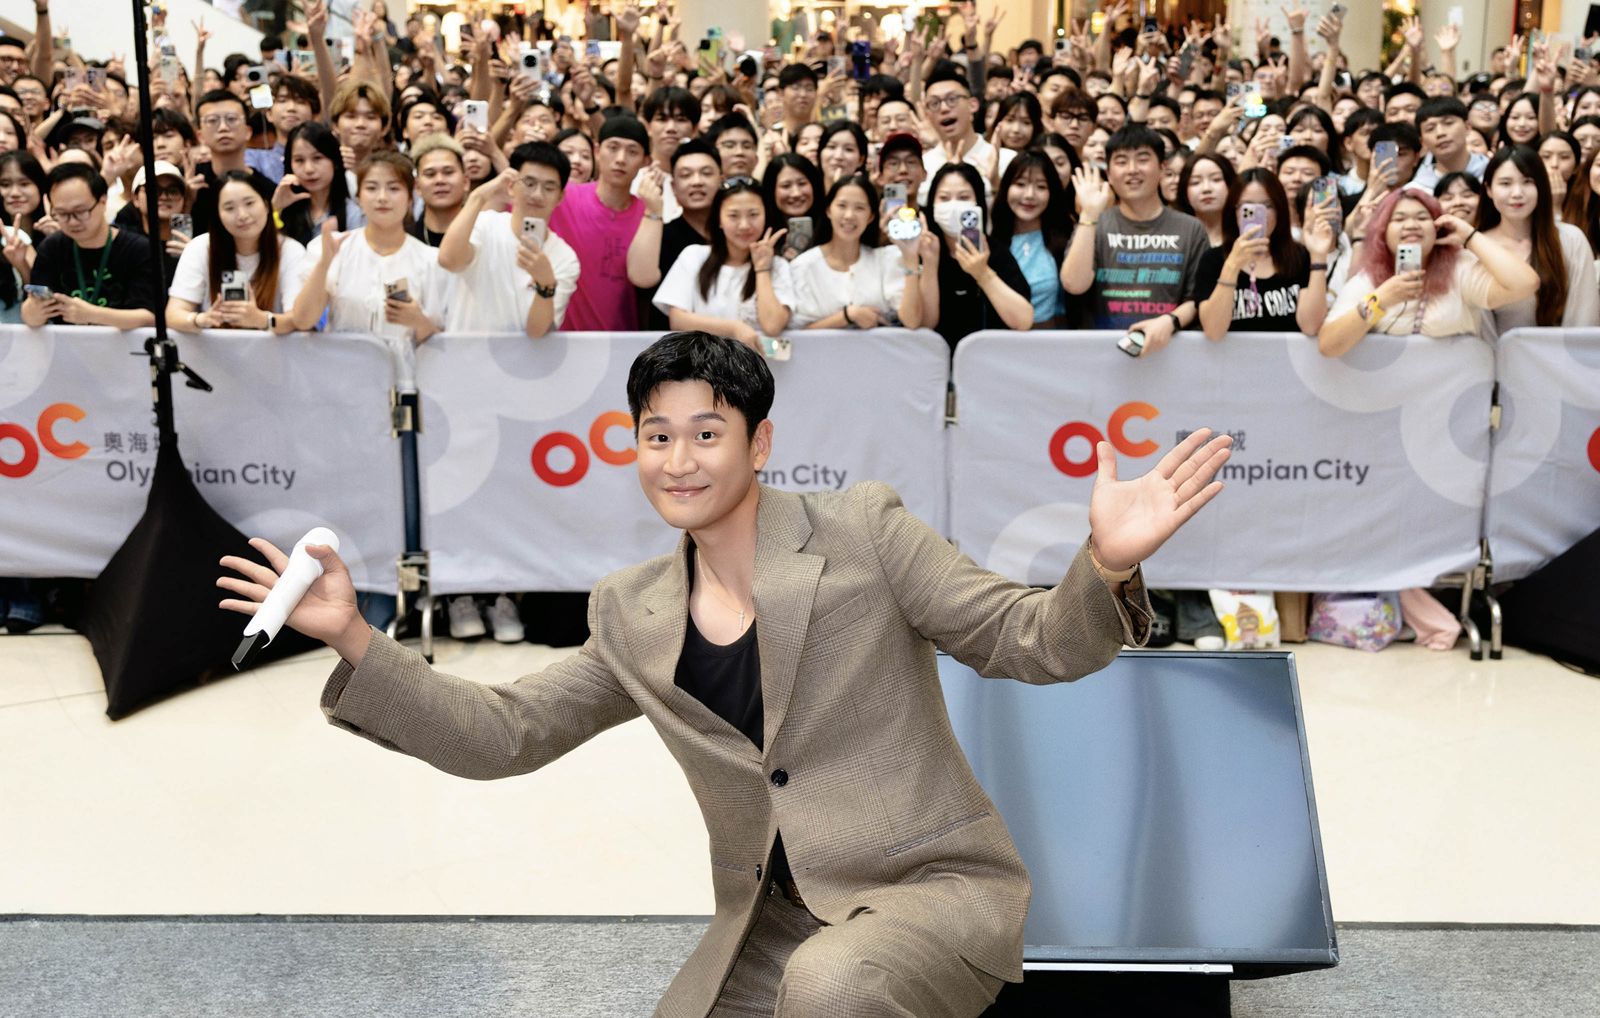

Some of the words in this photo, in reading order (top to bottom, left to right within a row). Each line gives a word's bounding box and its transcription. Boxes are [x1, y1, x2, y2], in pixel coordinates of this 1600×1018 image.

[104, 432, 161, 453] 奧海
[107, 461, 235, 487] Olyian
[242, 463, 295, 489] City
[792, 464, 847, 490] City
[1314, 459, 1369, 486] City
